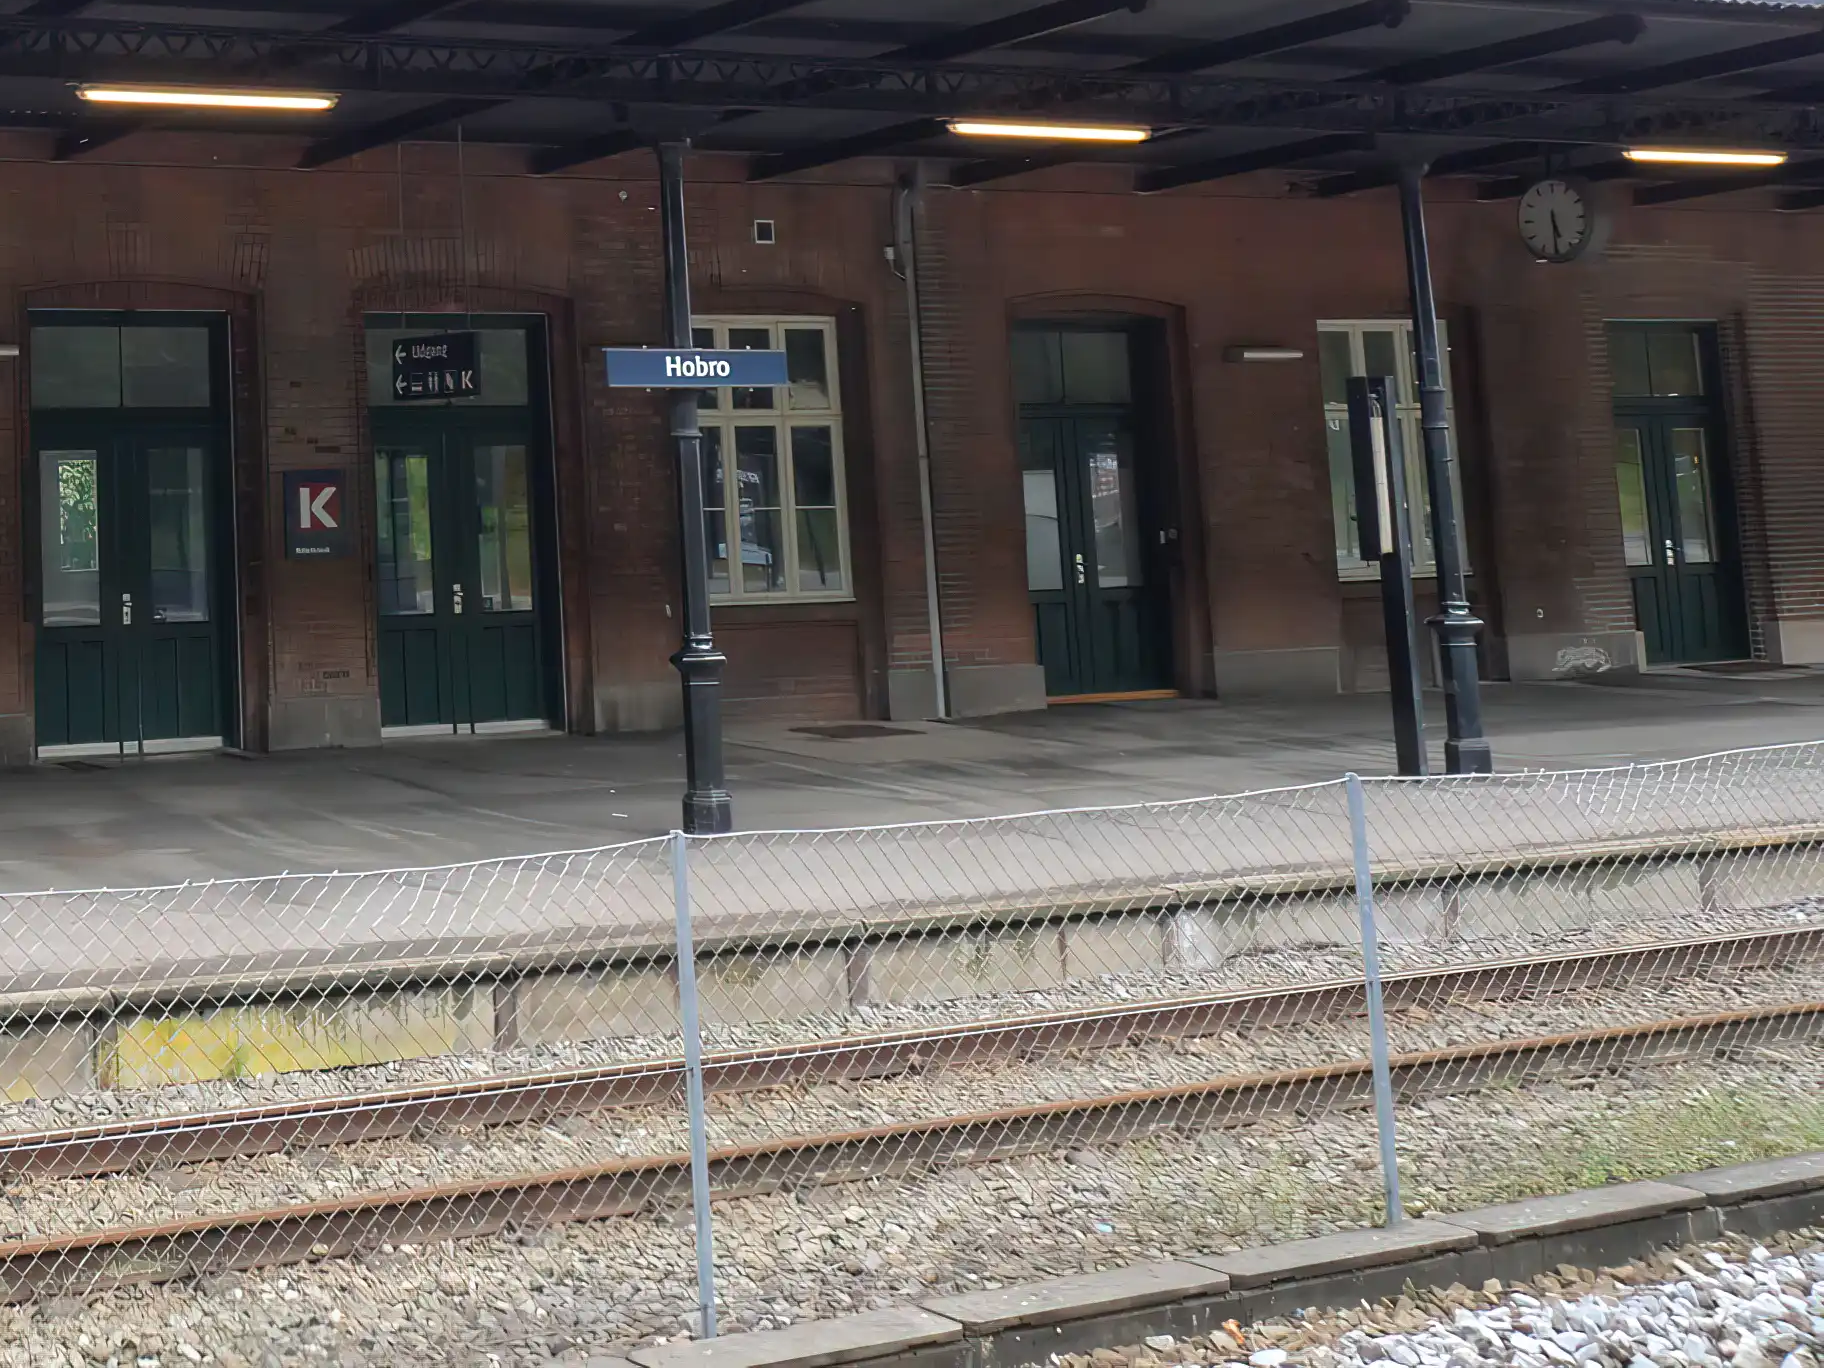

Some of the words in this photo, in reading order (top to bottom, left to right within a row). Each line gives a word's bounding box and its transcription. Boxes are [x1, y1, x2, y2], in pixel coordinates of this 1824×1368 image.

[665, 355, 731, 377] Hobro
[461, 370, 474, 389] K
[299, 486, 338, 529] K
